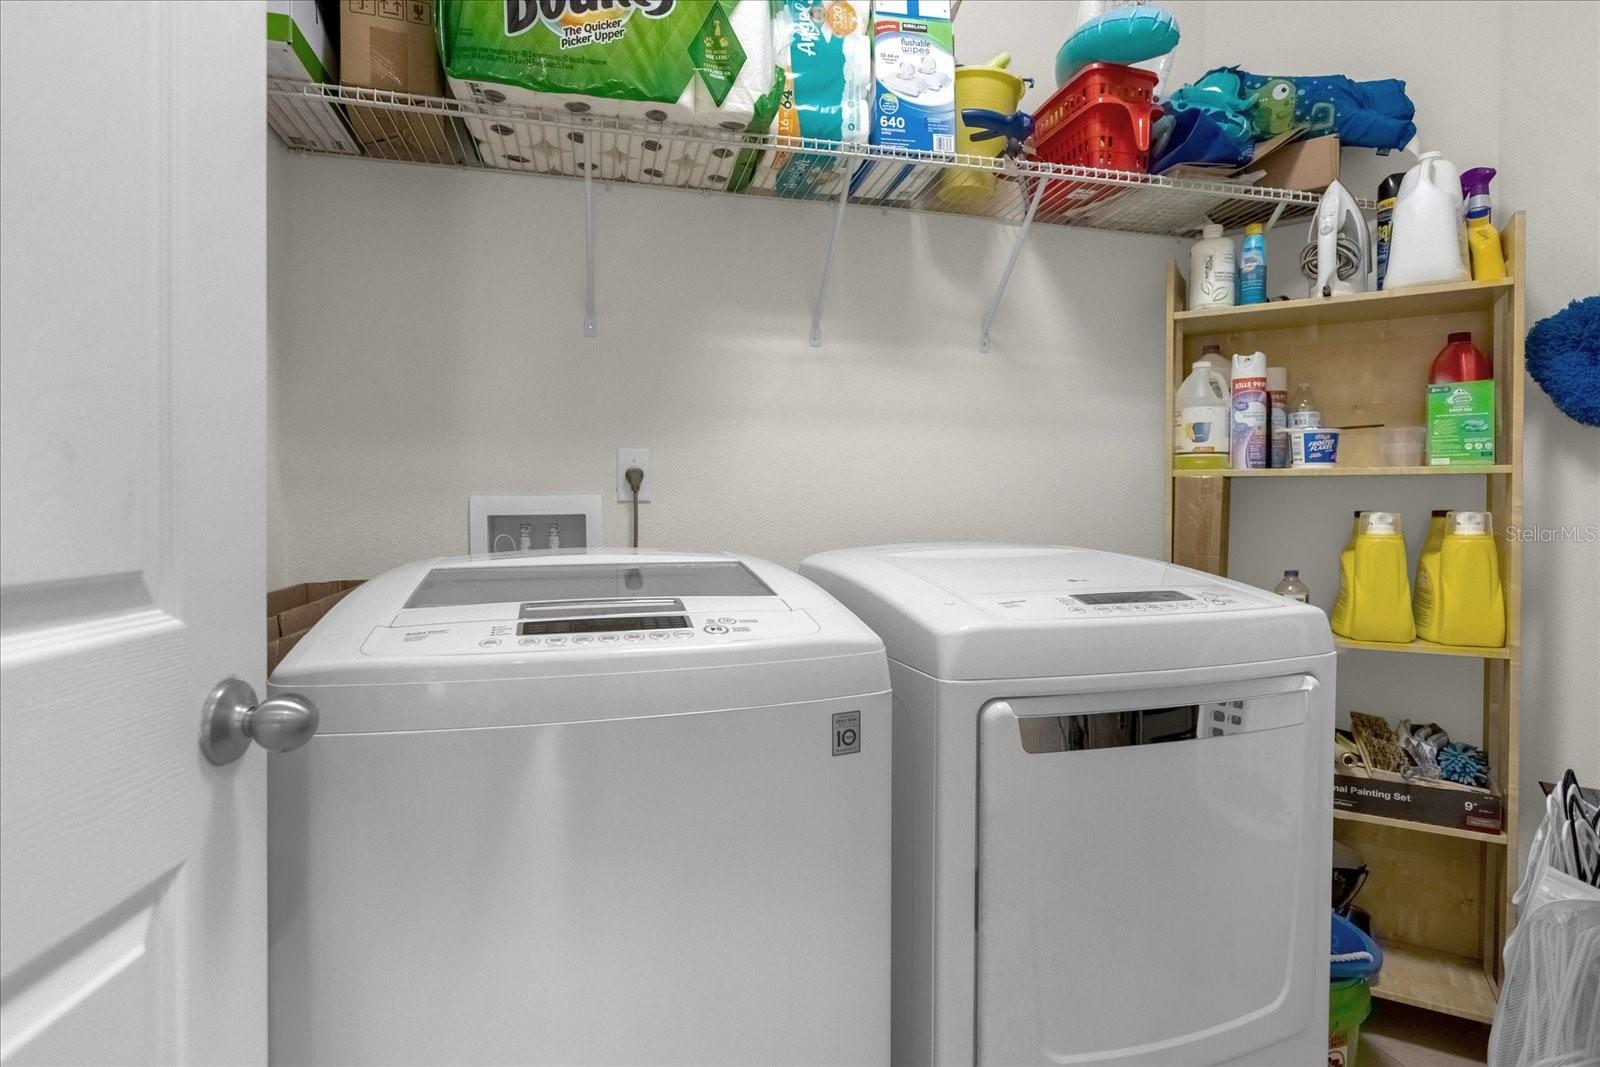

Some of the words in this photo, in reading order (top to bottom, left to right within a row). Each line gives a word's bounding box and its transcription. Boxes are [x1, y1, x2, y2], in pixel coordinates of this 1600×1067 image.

[506, 0, 674, 34] Bouy
[563, 26, 582, 37] The
[584, 19, 623, 33] Quicker
[561, 34, 592, 48] Picker
[595, 28, 625, 42] Upper
[901, 38, 931, 48] flushable
[902, 46, 931, 55] wipes
[780, 89, 793, 109] 64
[880, 115, 905, 129] 640
[1309, 439, 1335, 448] FROSTED
[836, 728, 857, 748] 10
[1350, 786, 1391, 801] Painting
[1393, 792, 1411, 802] Set
